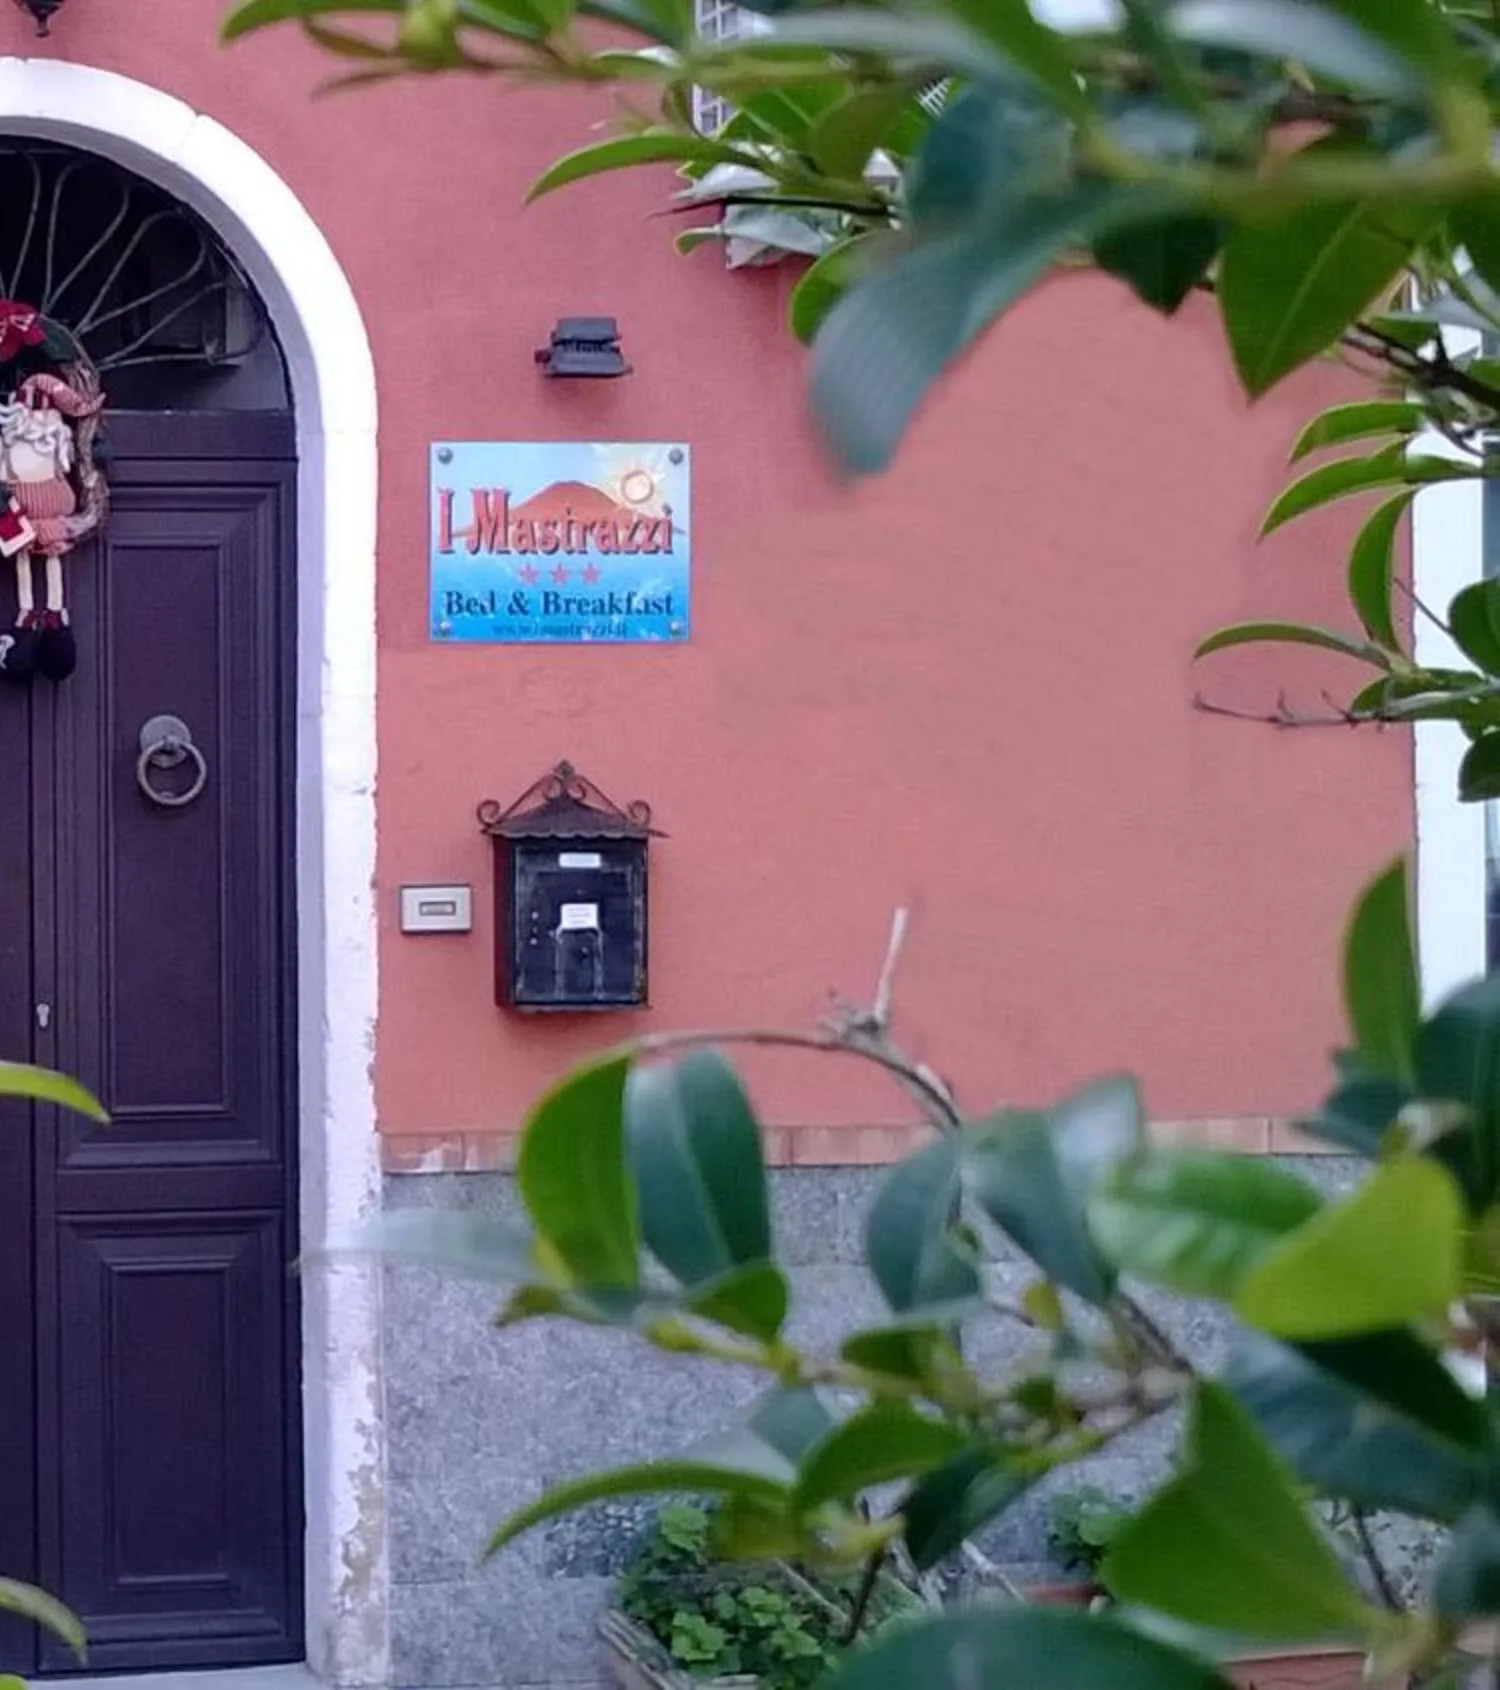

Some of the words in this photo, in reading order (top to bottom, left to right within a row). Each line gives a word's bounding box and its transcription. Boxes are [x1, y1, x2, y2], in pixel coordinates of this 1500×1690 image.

[437, 487, 455, 555] I
[466, 487, 674, 555] Mastrazzi
[445, 590, 498, 616] Bed
[507, 590, 530, 616] &
[543, 590, 674, 617] Breakfast
